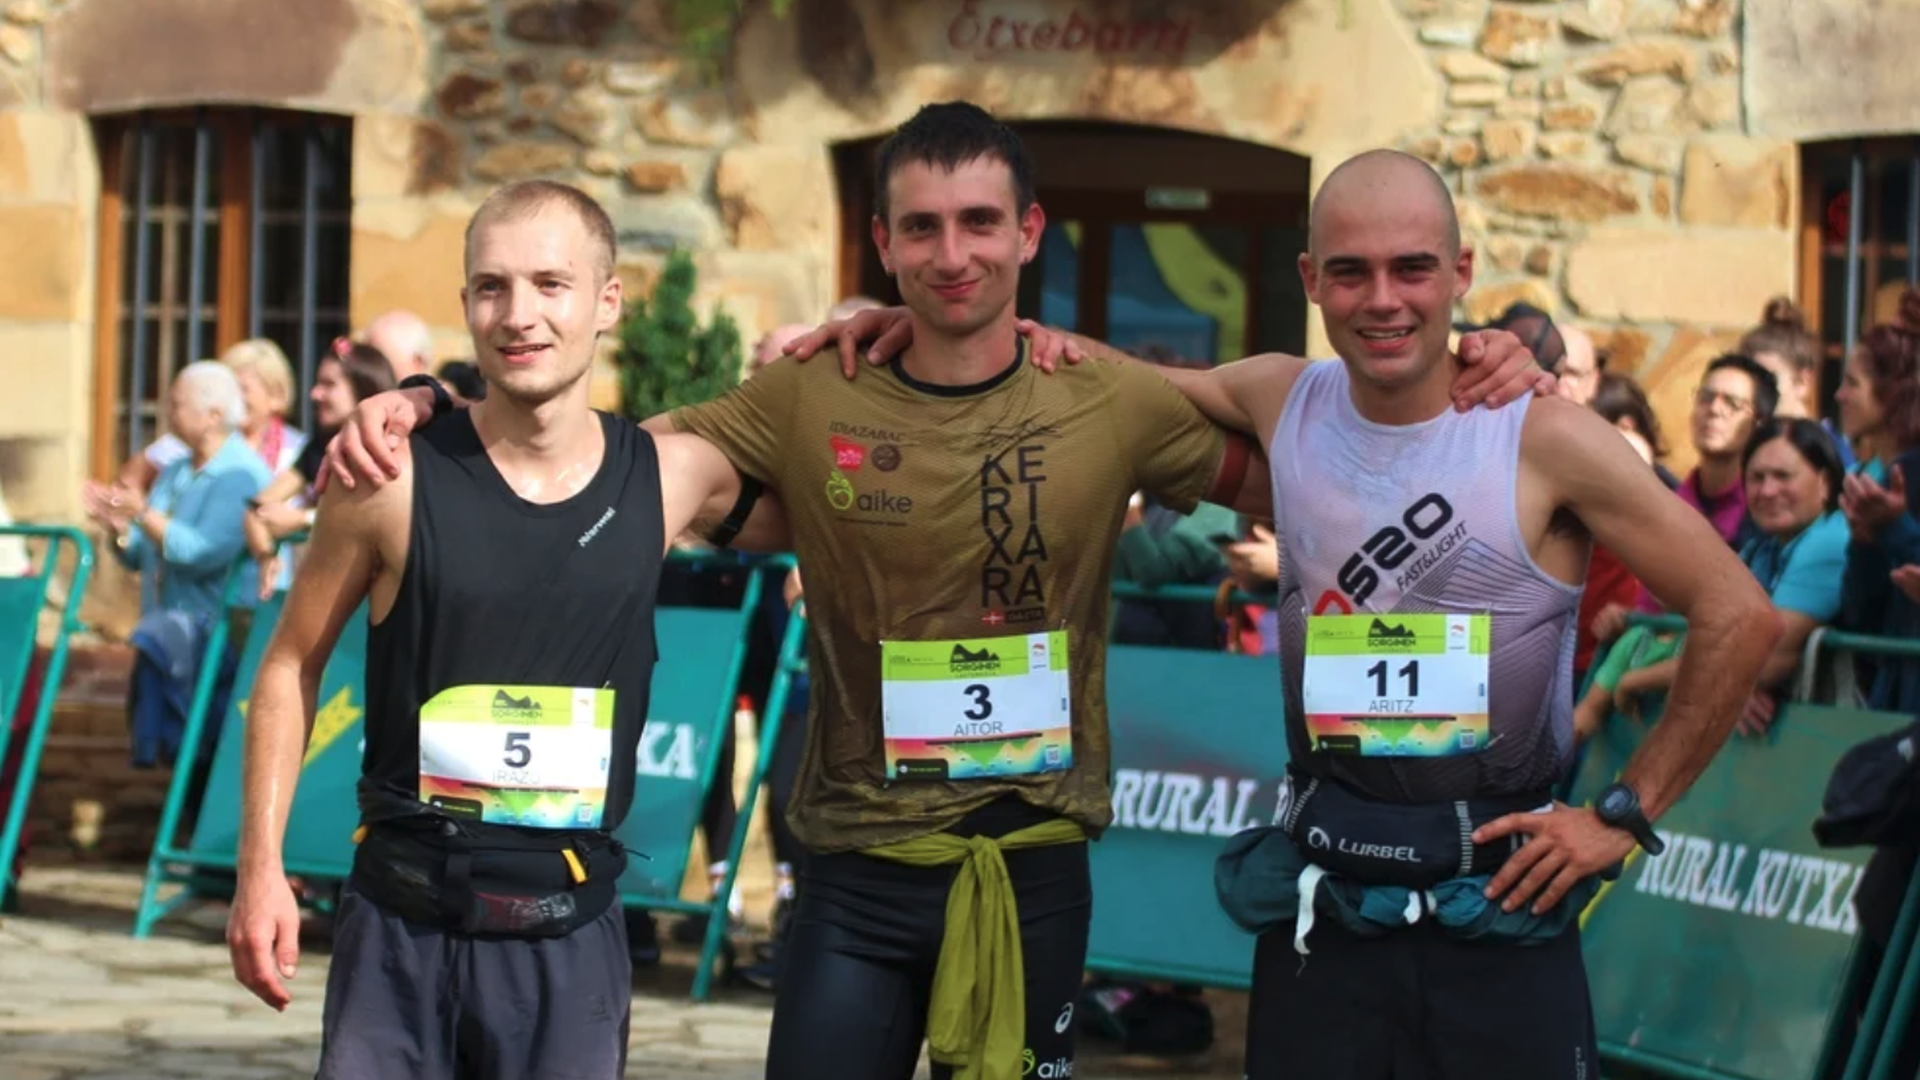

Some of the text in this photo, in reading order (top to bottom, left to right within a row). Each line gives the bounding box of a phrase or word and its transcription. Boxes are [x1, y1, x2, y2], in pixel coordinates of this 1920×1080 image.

[857, 489, 912, 513] aike
[1396, 520, 1468, 592] FAST&LIGHT
[1367, 660, 1418, 697] 11
[963, 683, 993, 720] 3
[1368, 700, 1414, 713] ARITZ
[953, 721, 1004, 736] AITOR
[503, 731, 532, 768] 5
[1110, 767, 1259, 837] RURAL
[1338, 838, 1422, 863] LURBEL
[1635, 829, 1748, 912] RURAL
